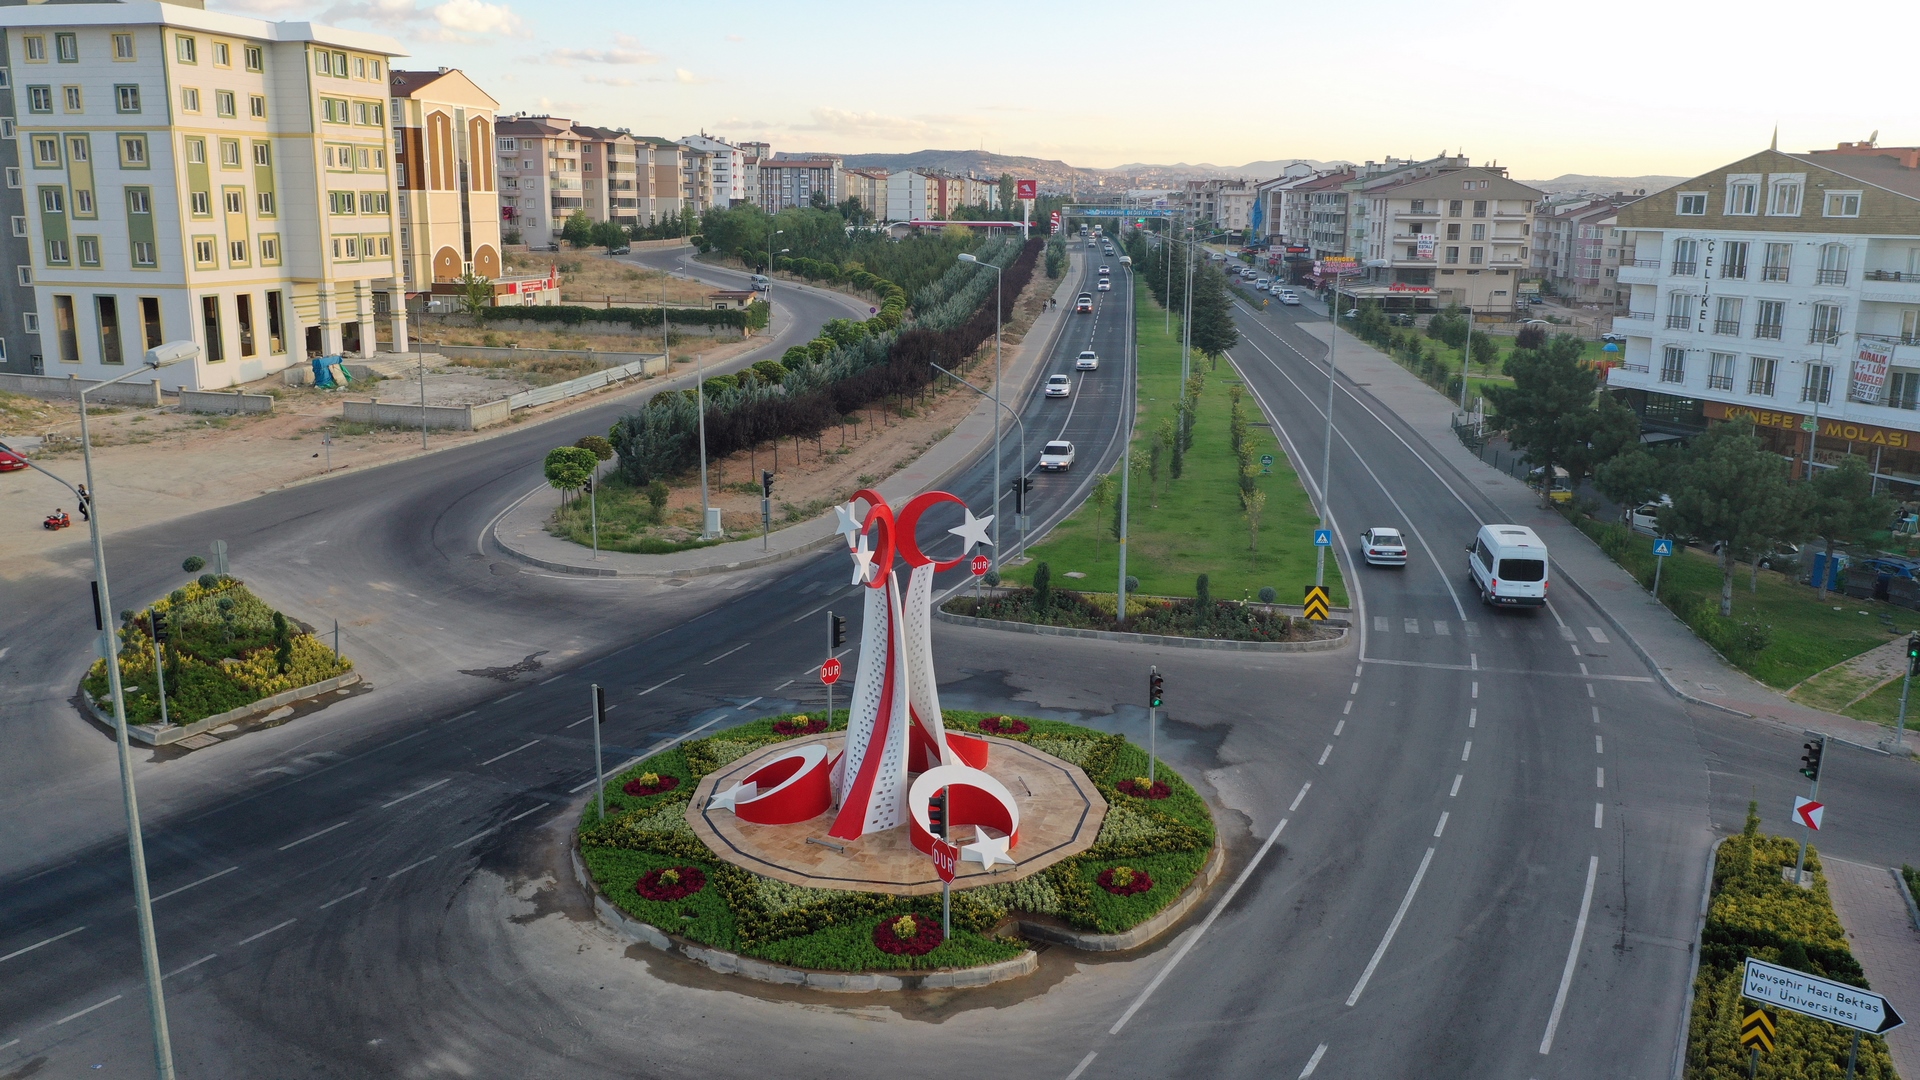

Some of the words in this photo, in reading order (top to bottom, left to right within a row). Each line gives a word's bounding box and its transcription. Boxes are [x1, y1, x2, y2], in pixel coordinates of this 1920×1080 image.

[1698, 241, 1715, 333] ÇELİKEL
[1859, 350, 1887, 365] KİRALIK
[1825, 422, 1909, 448] MOLASI
[971, 560, 988, 570] DUR
[822, 665, 839, 677] DUR
[933, 848, 954, 875] DUR
[1750, 981, 1771, 996] Veli
[1779, 988, 1858, 1021] Üniversitesi
[1751, 967, 1803, 991] Nevşehir
[1807, 984, 1832, 999] Hacı
[1836, 992, 1879, 1013] Bektaş
